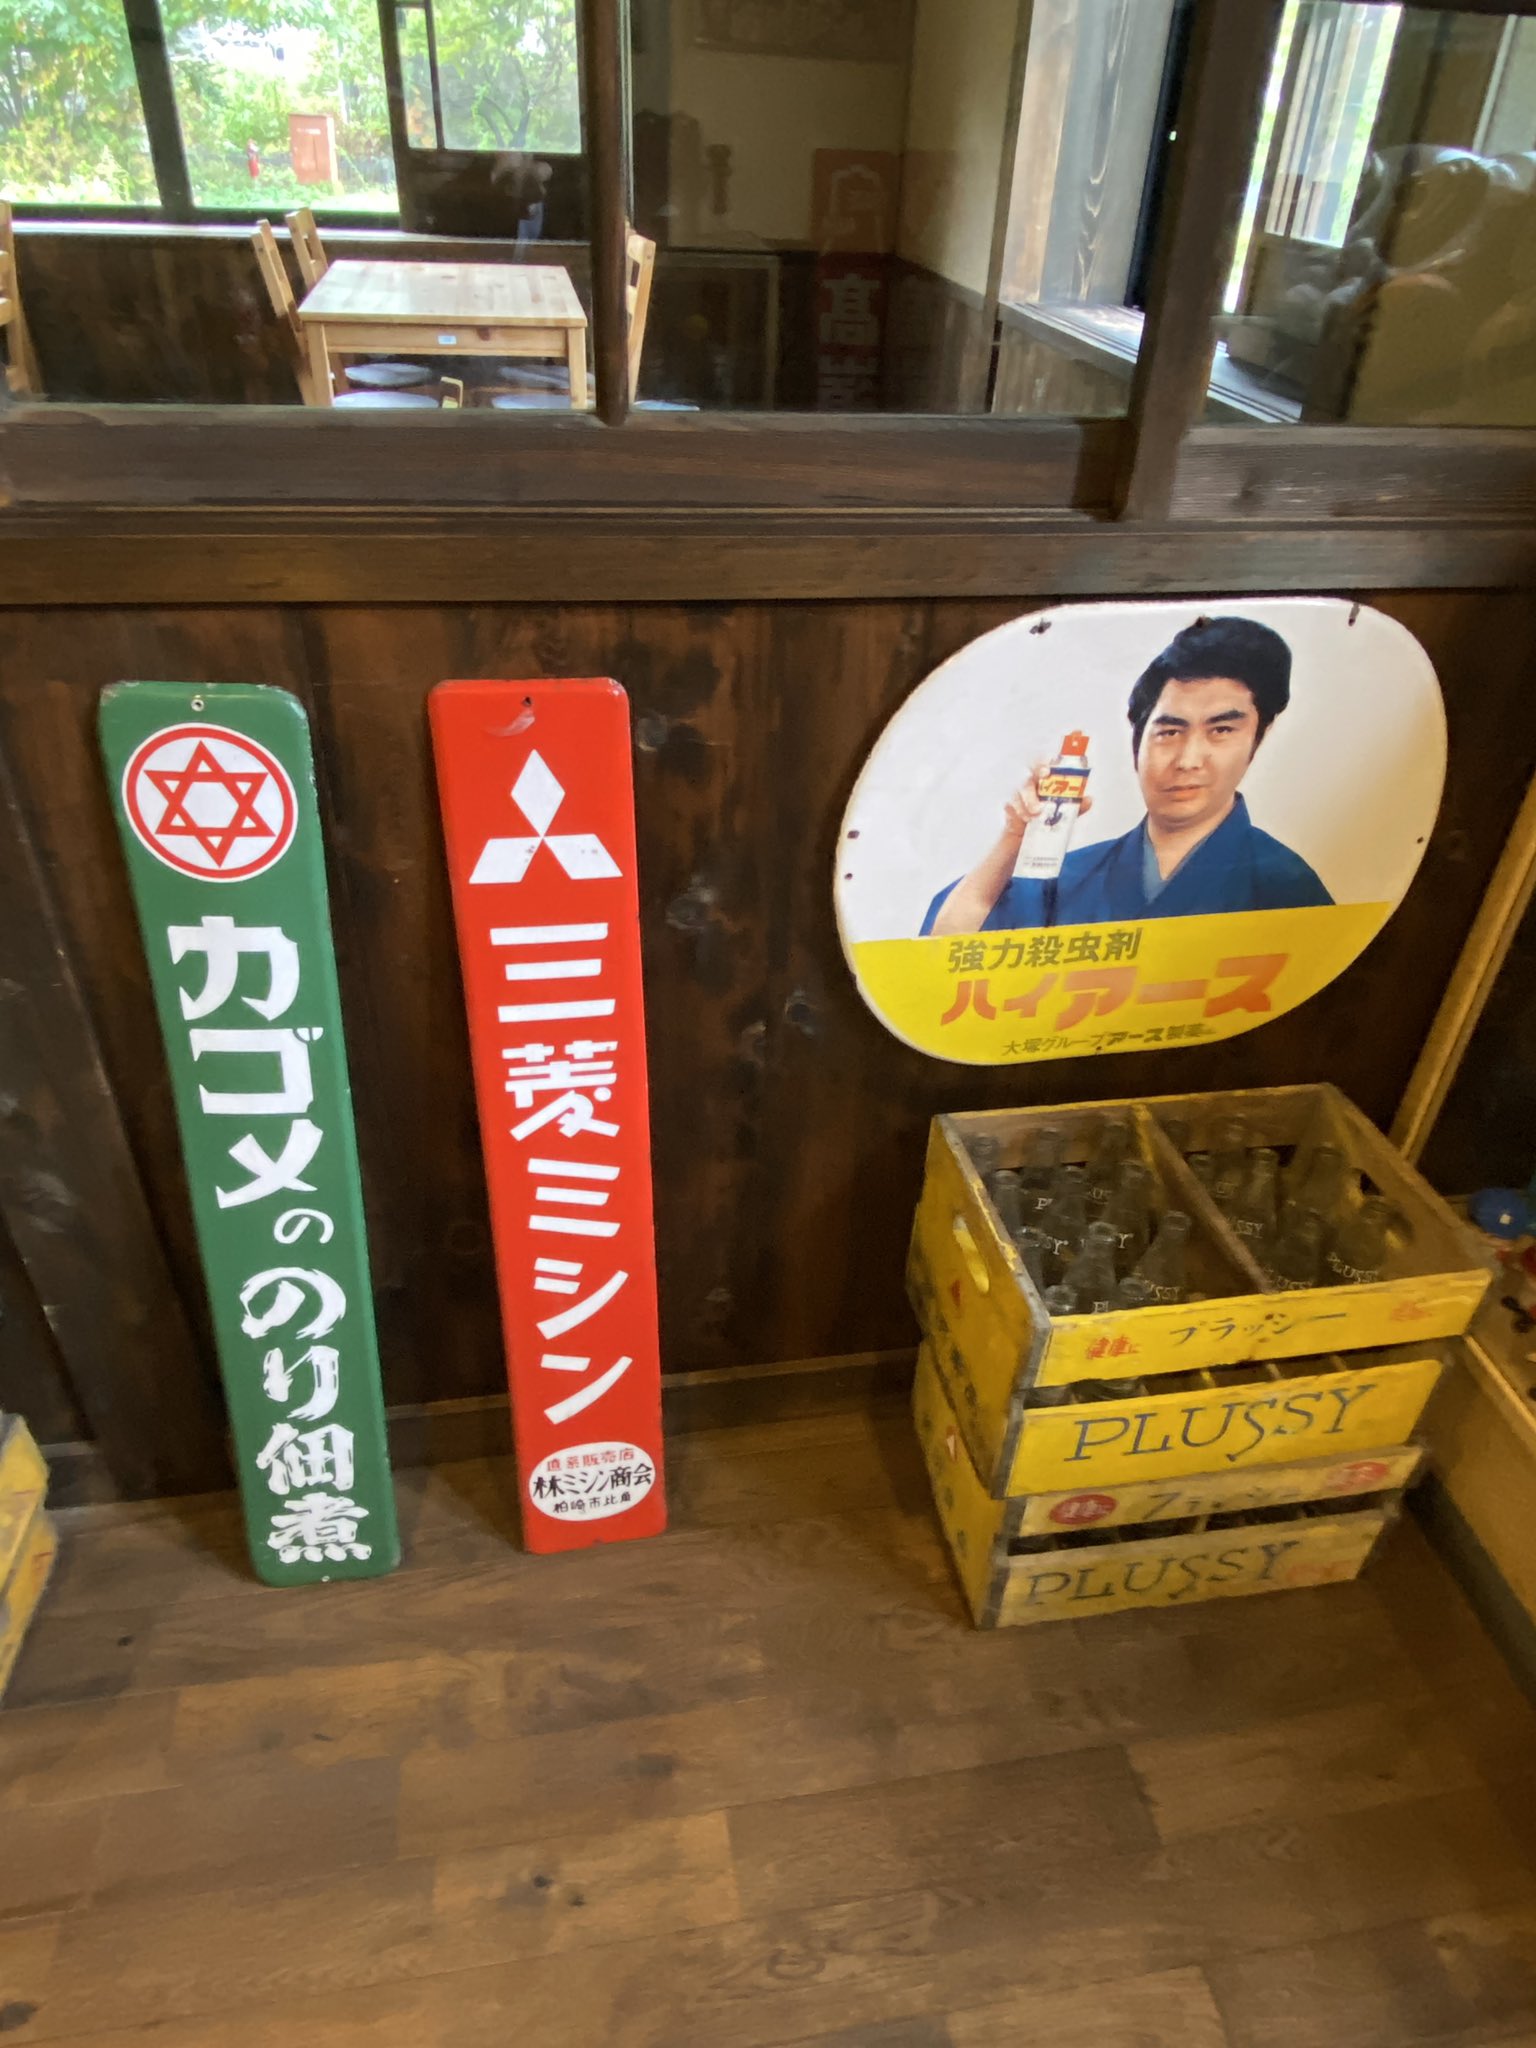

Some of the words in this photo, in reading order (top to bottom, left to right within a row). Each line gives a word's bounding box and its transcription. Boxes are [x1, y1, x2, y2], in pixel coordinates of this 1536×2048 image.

[948, 928, 1144, 973] 強力殺虫剤
[940, 953, 1290, 1032] ハイアース
[489, 922, 633, 1425] 三菱ミシン
[166, 916, 372, 1563] カゴメののり佃煮
[1064, 1383, 1377, 1462] PLUSSY
[532, 1463, 653, 1499] 林ミシン商会
[1026, 1540, 1300, 1606] PLUSSY
